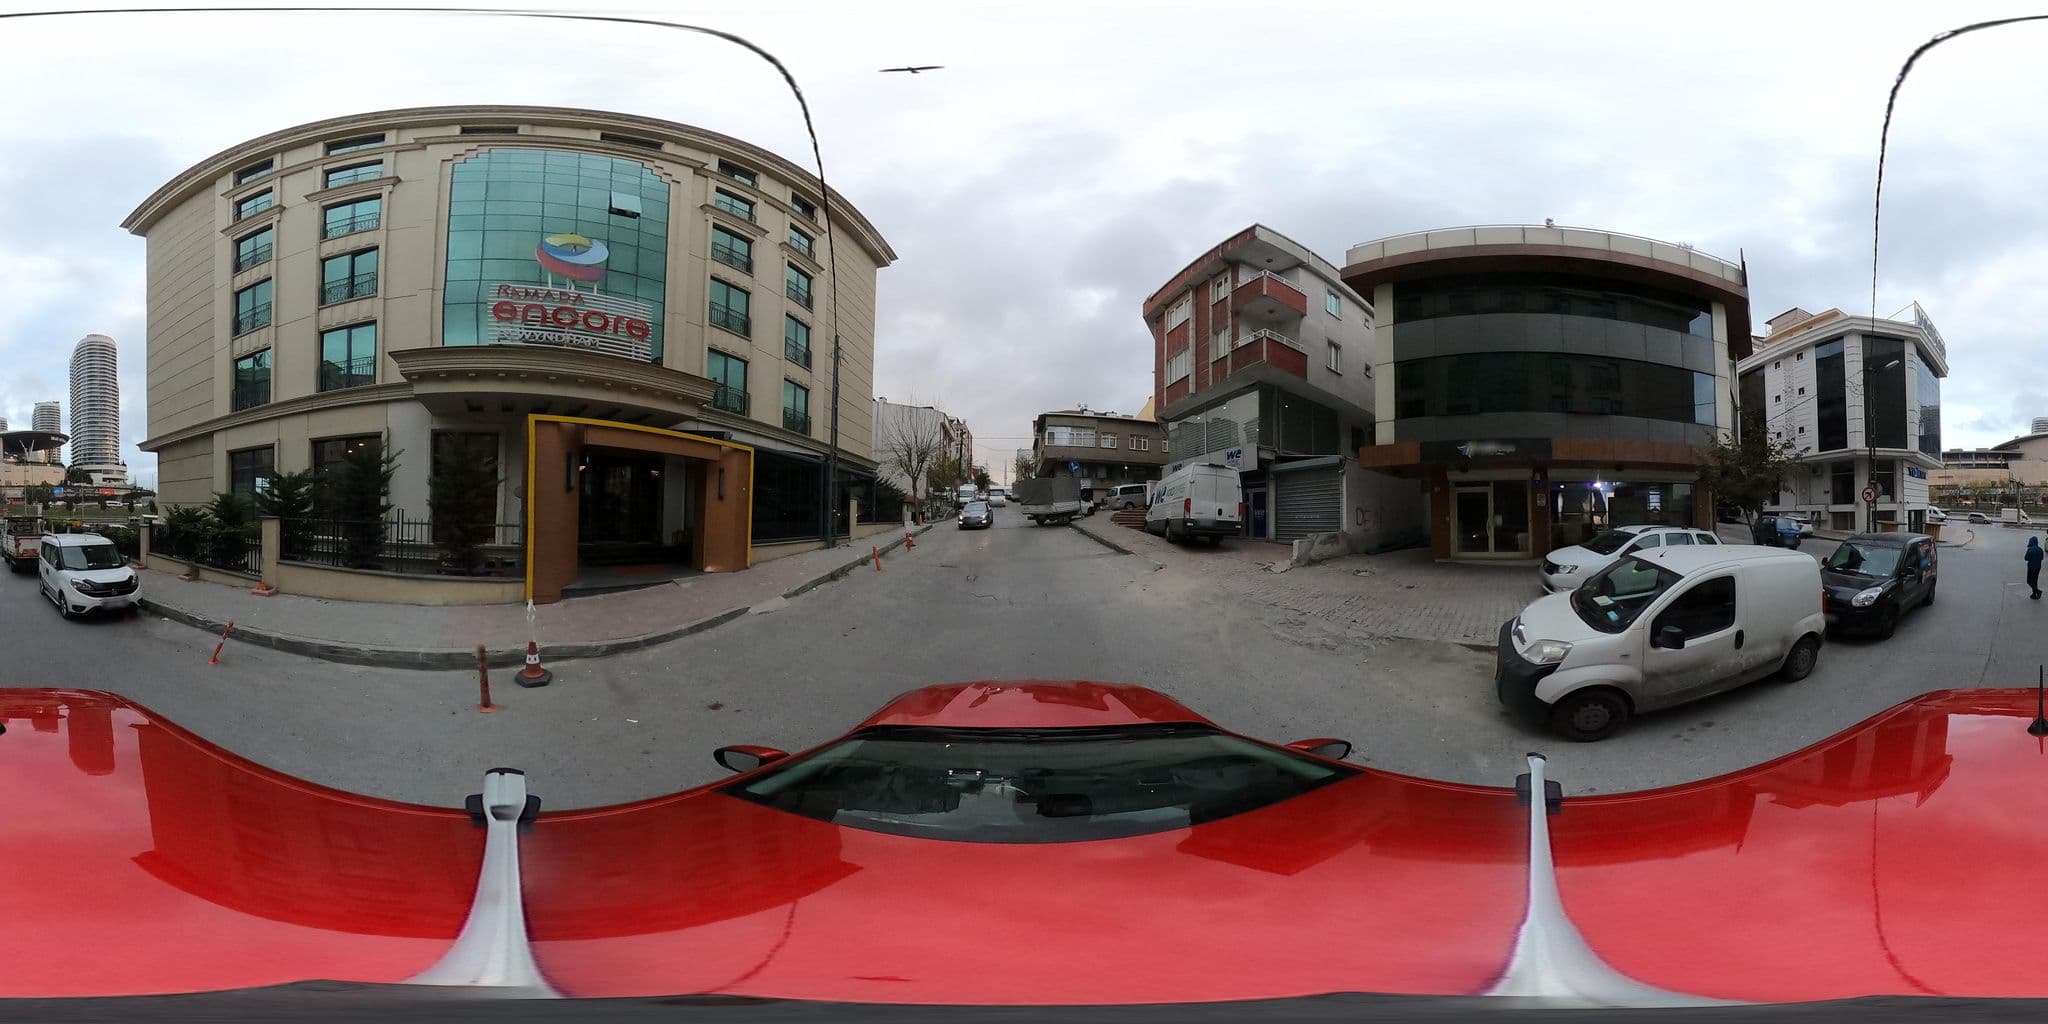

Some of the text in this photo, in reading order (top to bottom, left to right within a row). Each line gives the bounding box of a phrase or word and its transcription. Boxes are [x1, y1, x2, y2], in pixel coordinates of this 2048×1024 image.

[497, 284, 584, 305] RAMADA
[492, 301, 650, 341] encore
[519, 327, 600, 347] WYNDHAM
